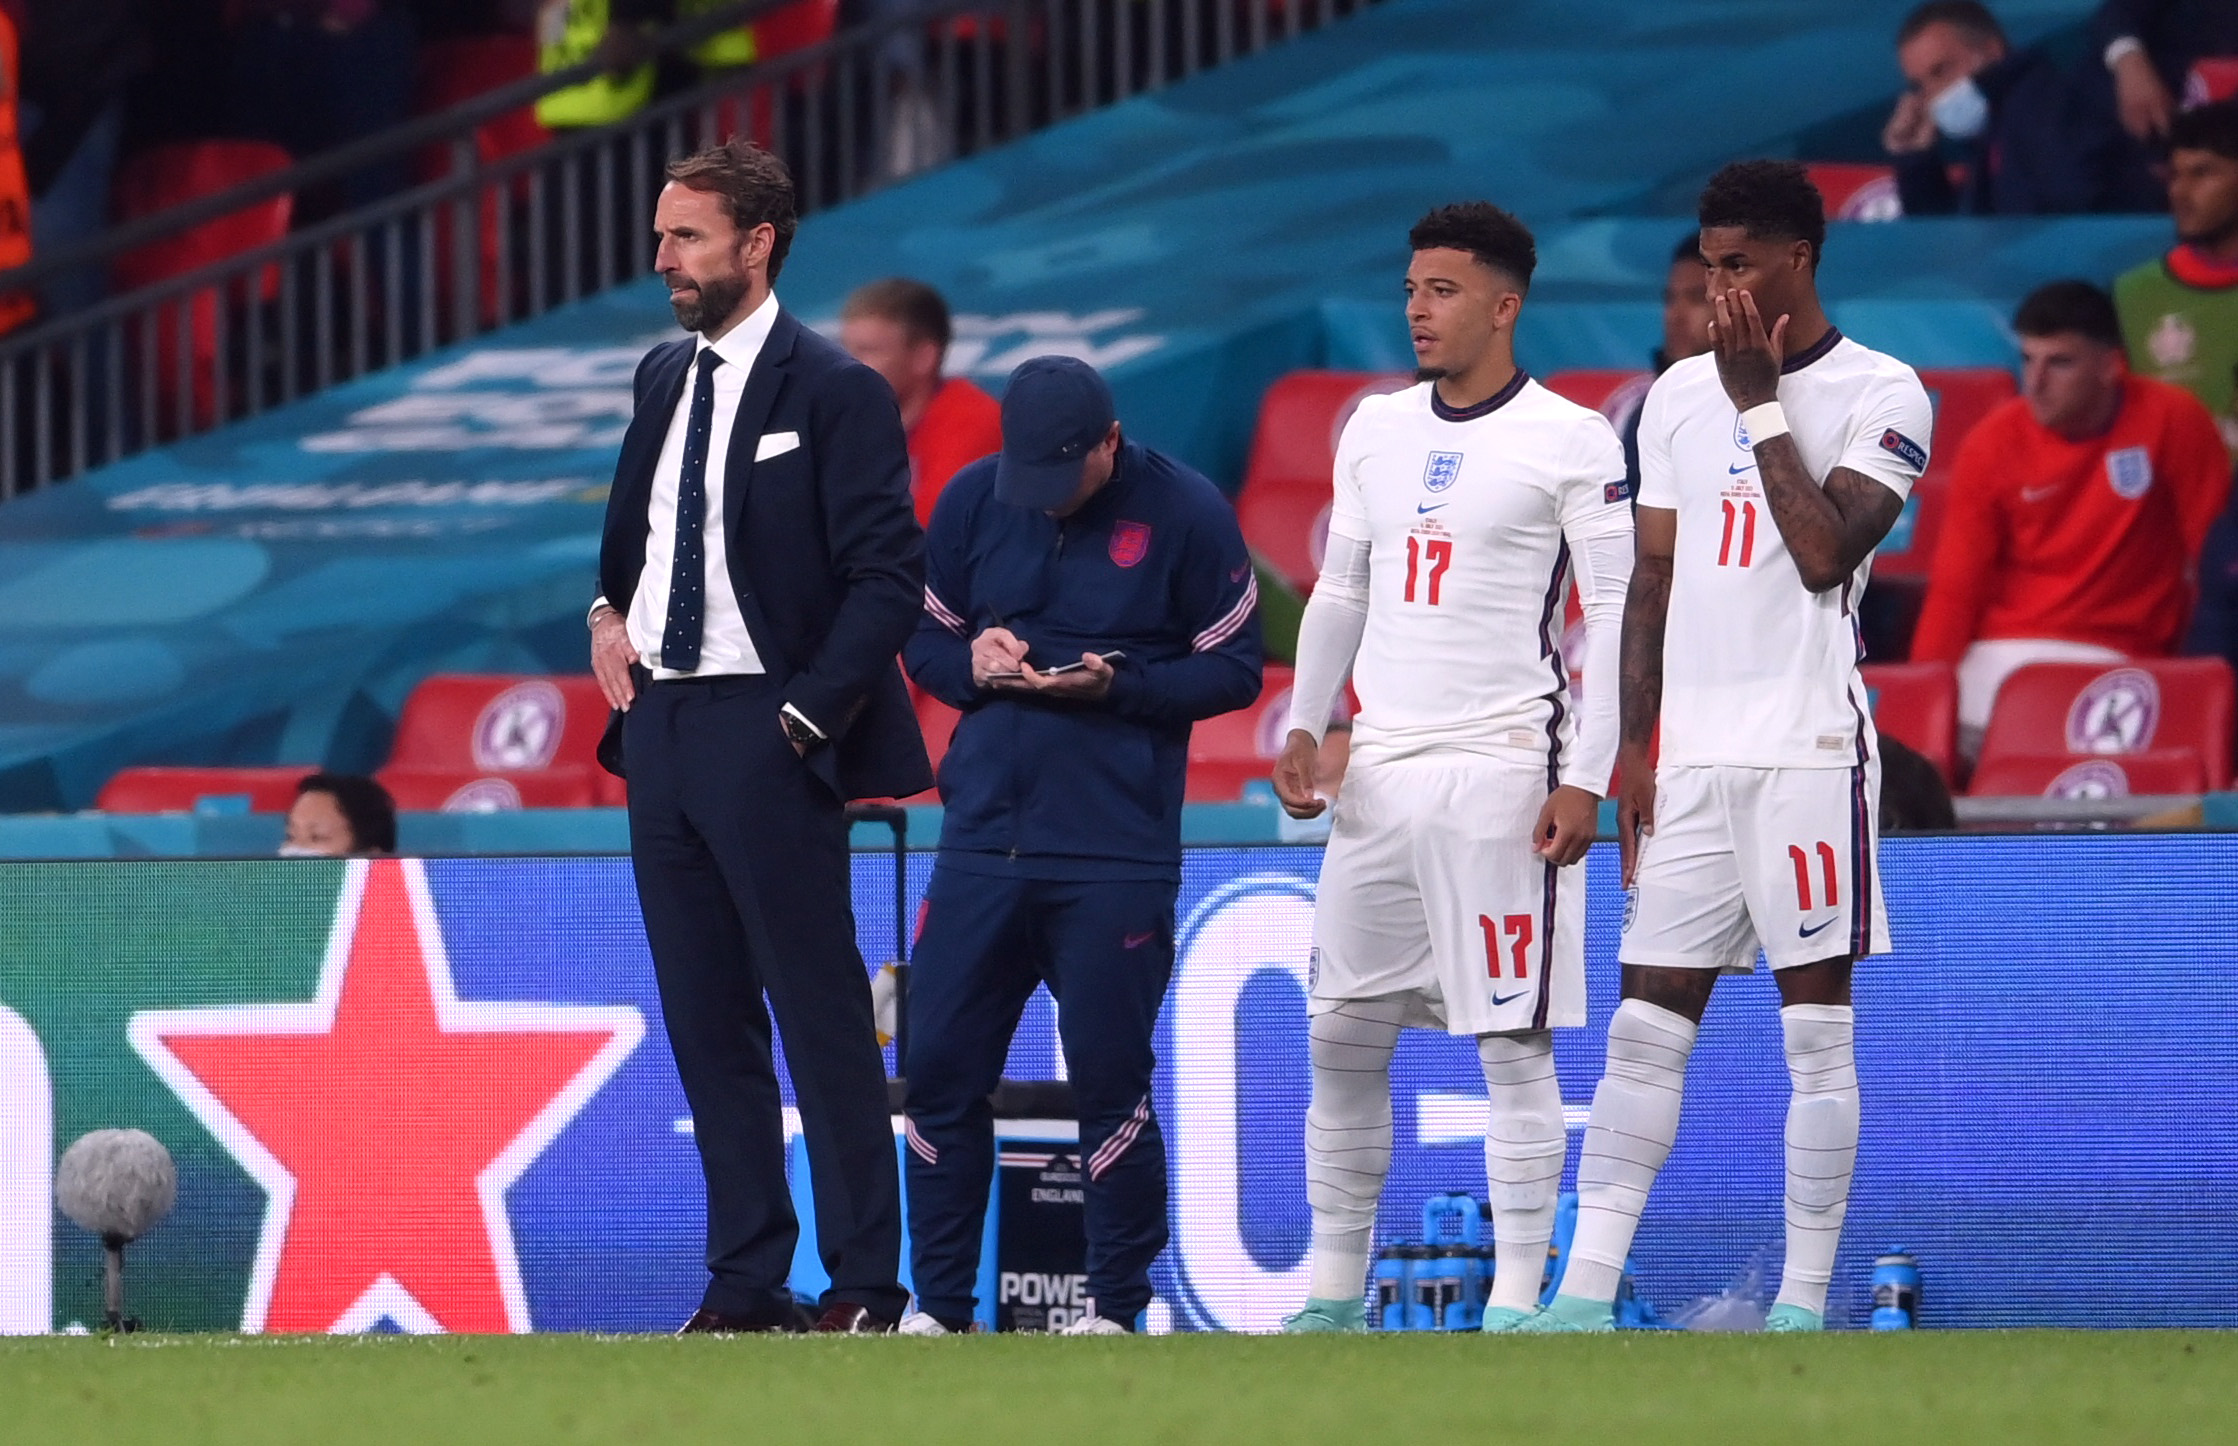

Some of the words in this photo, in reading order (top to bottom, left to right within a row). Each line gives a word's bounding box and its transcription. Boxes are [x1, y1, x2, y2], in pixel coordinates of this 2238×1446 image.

[1717, 498, 1756, 567] 11
[1404, 535, 1452, 606] 17
[1788, 841, 1838, 911] 11
[1479, 913, 1533, 979] 17
[1000, 1271, 1089, 1307] POWE
